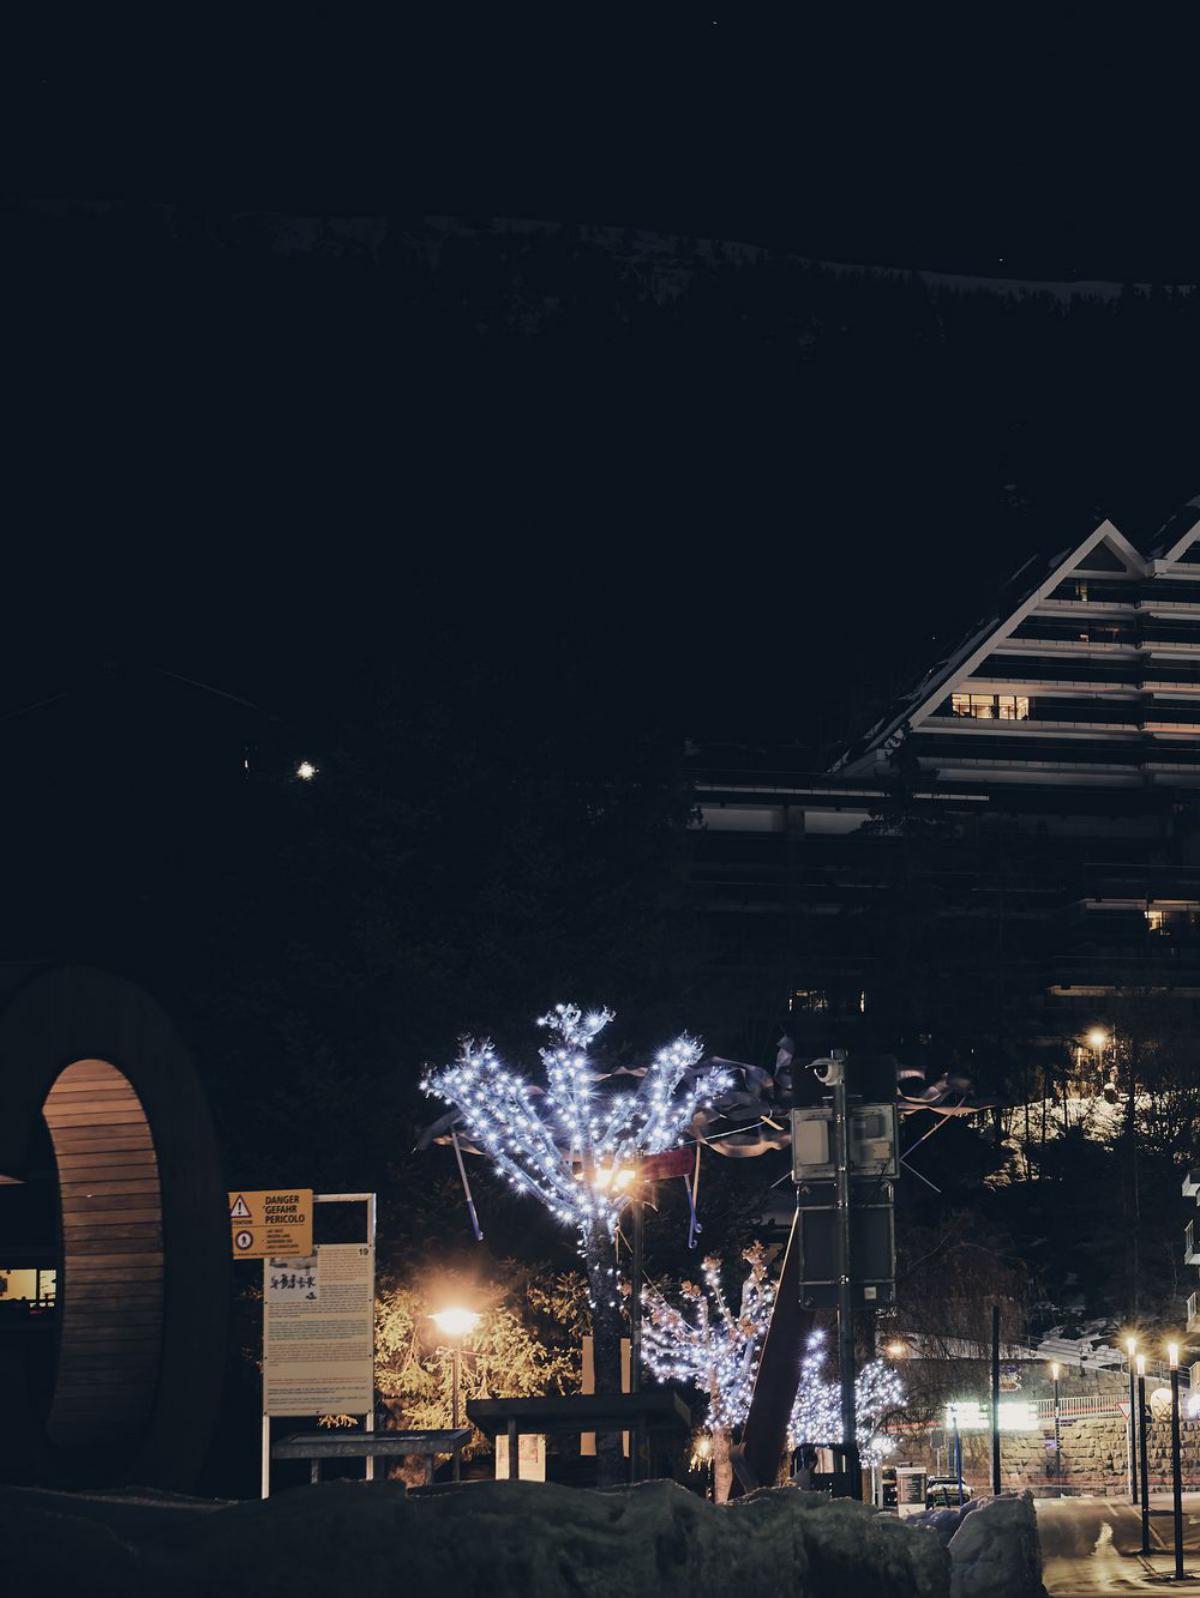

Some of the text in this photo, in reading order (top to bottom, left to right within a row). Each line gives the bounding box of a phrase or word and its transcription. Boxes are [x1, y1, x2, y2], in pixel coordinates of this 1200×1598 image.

[265, 1195, 300, 1205] DANGER
[264, 1205, 297, 1214] GEFAHR
[264, 1214, 306, 1224] PERICOLO
